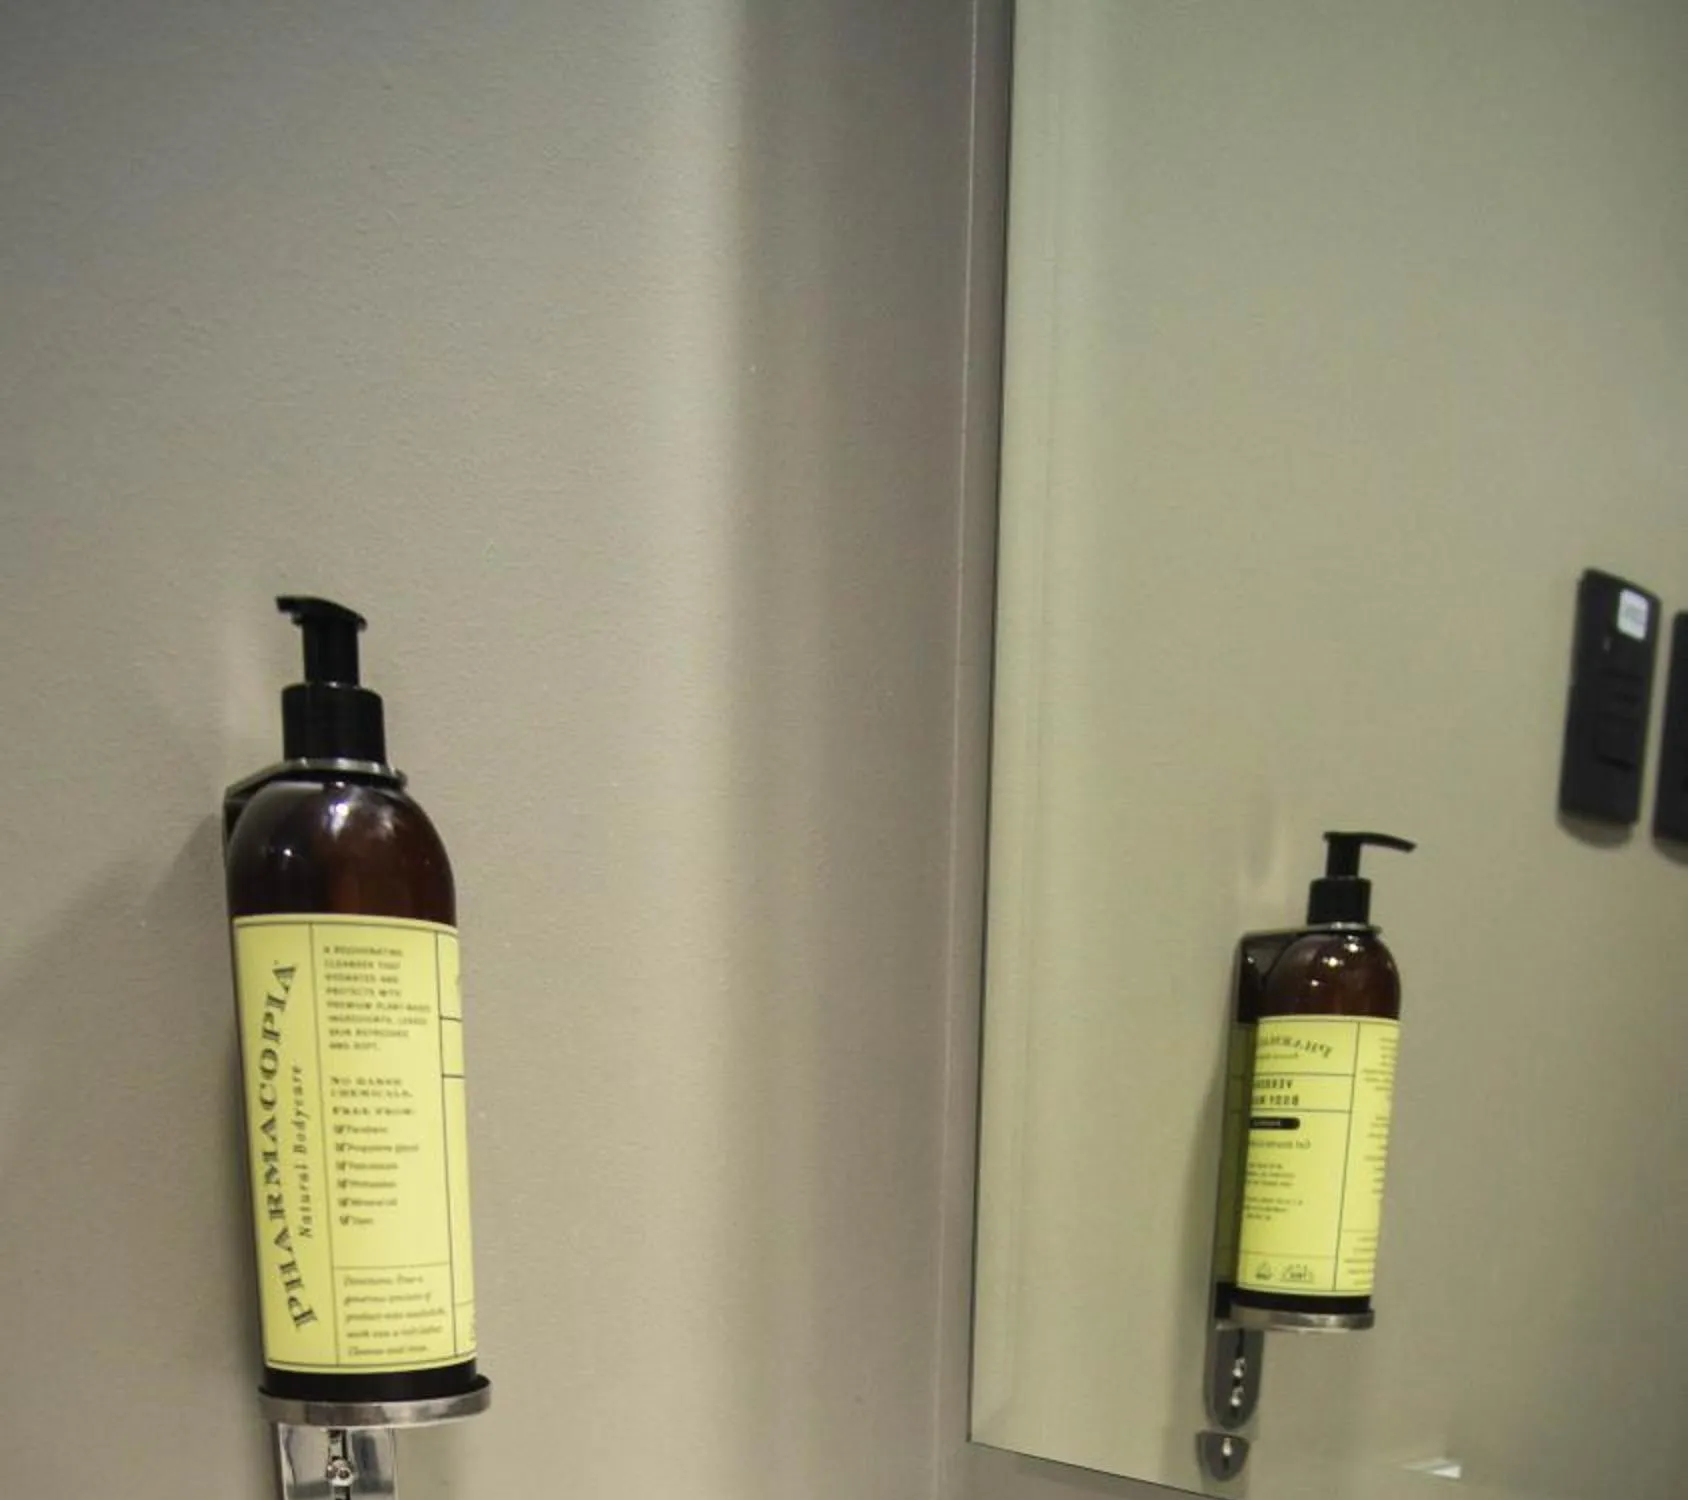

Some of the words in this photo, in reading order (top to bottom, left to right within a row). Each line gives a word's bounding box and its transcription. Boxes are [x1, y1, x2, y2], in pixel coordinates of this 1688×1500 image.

[257, 963, 318, 1330] PHARMACOPIA
[290, 1064, 312, 1156] Bodycare
[294, 1163, 314, 1240] Natural
